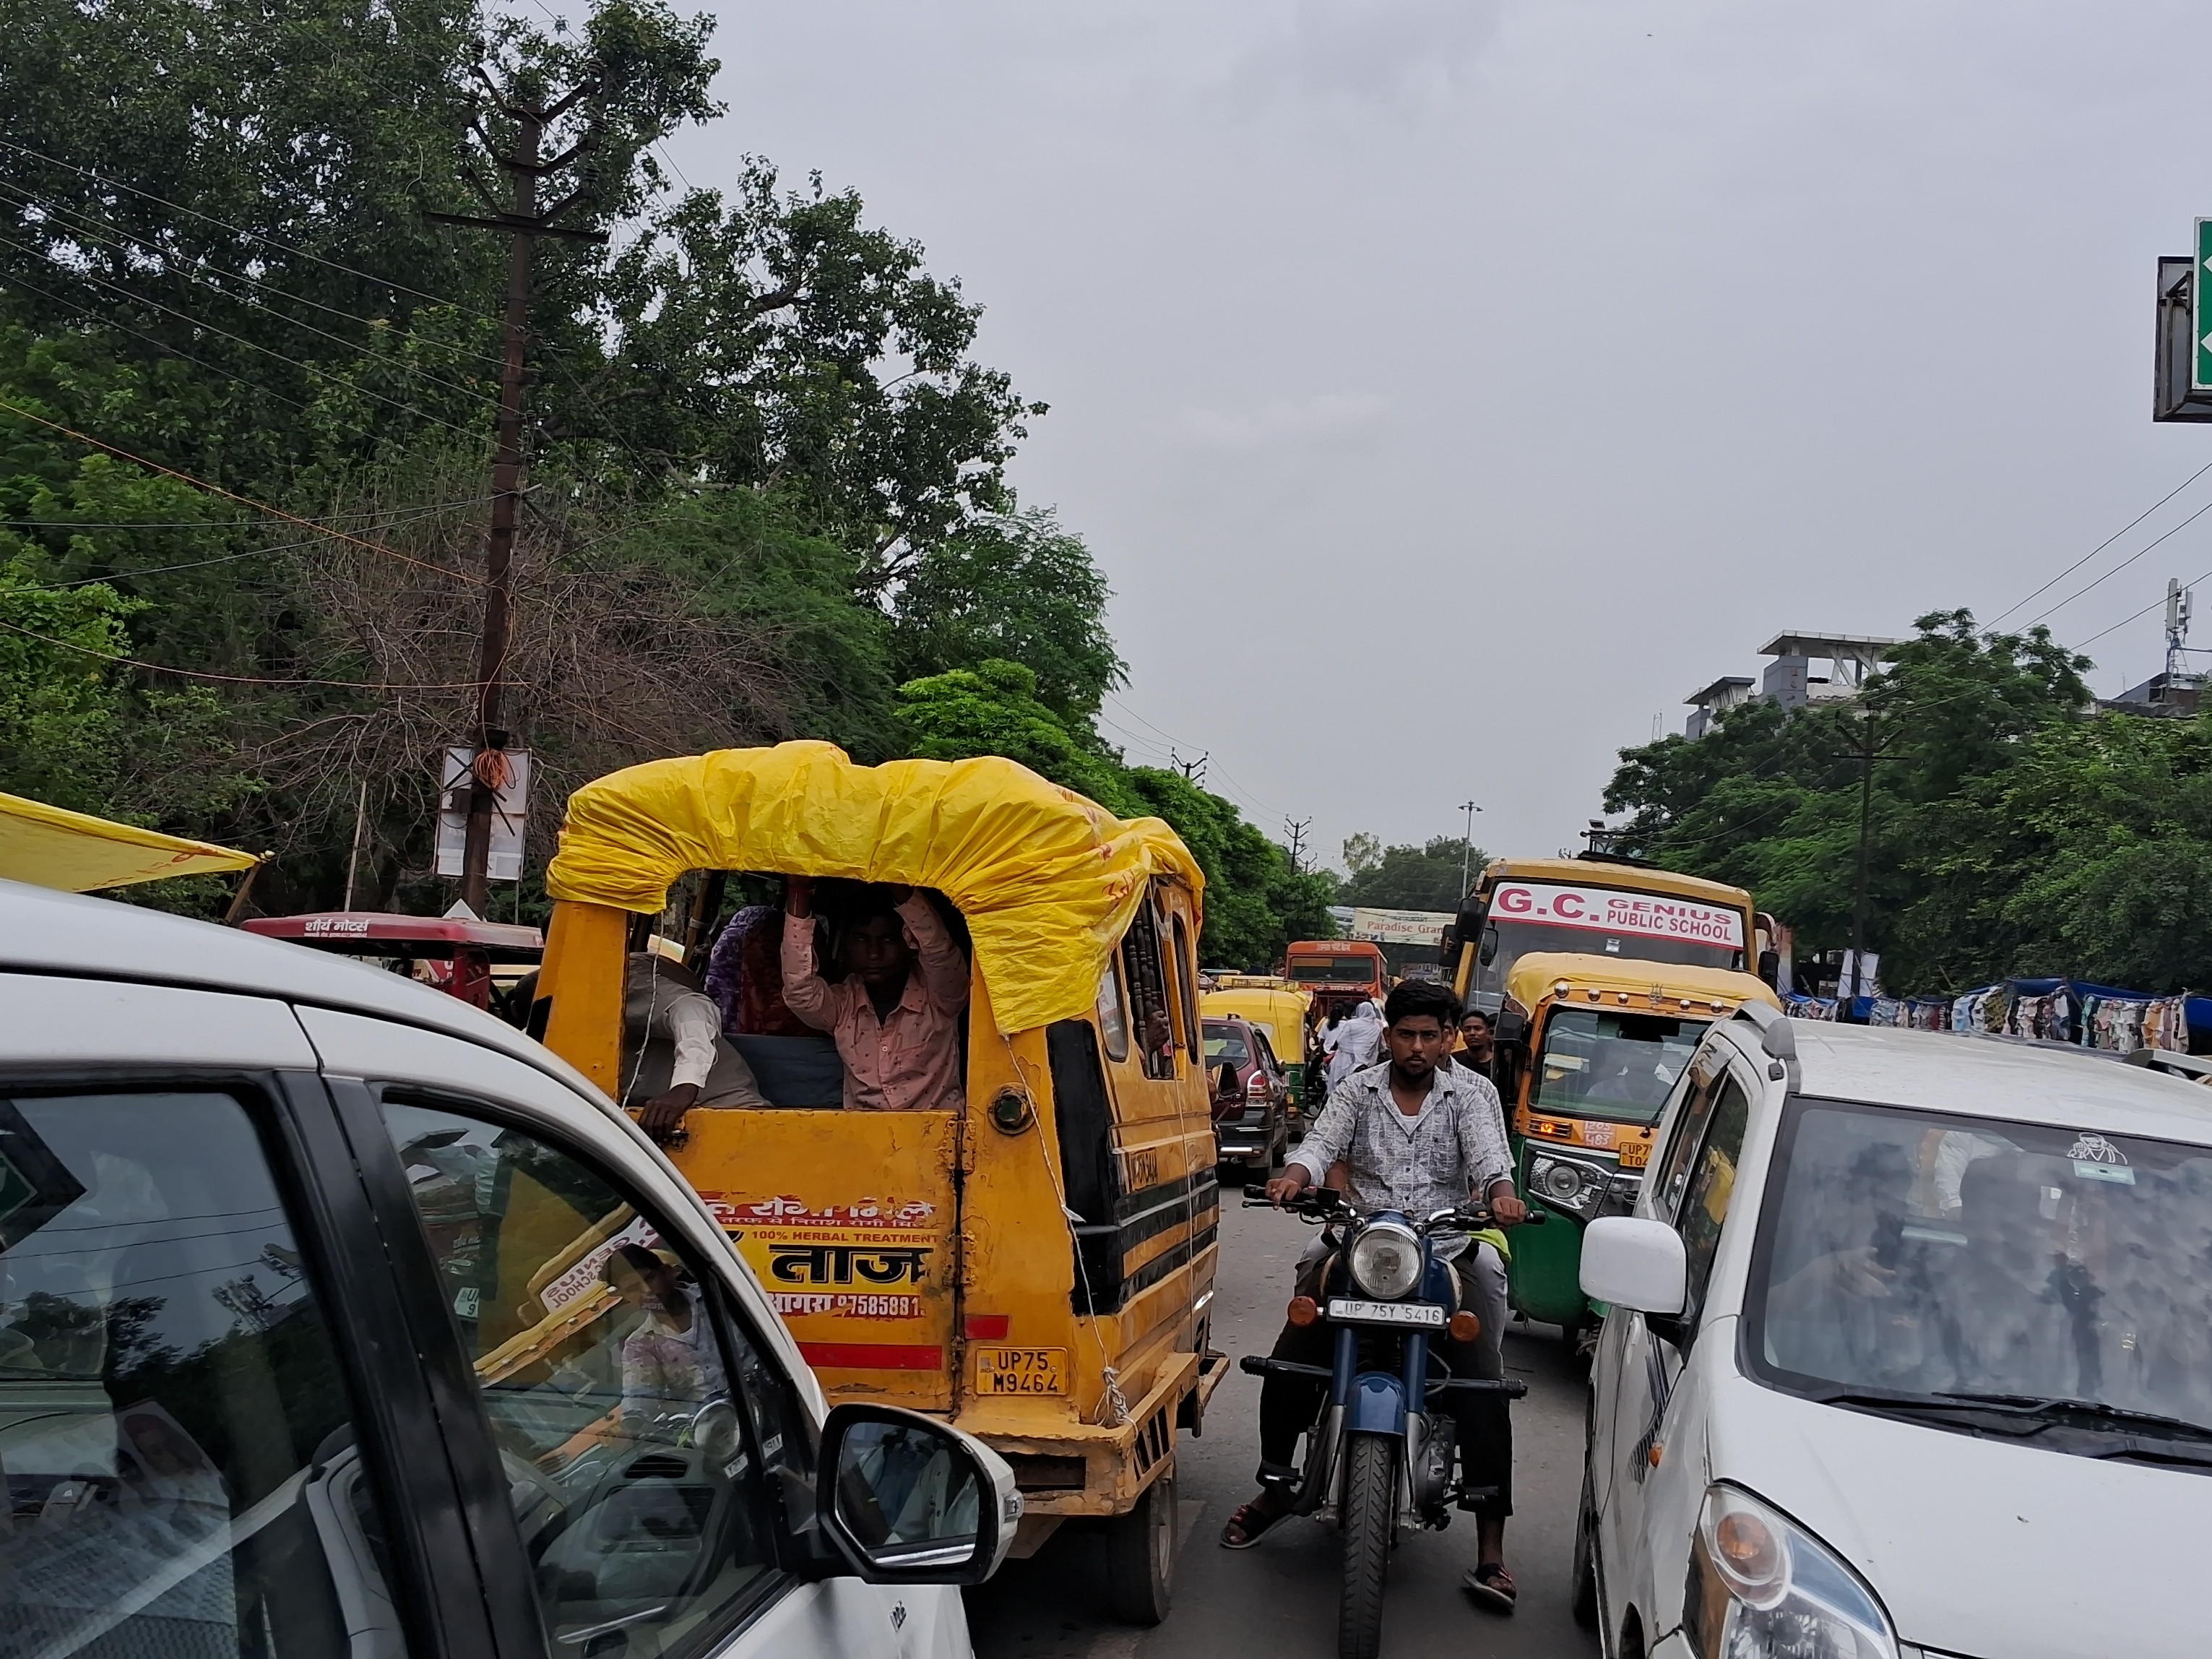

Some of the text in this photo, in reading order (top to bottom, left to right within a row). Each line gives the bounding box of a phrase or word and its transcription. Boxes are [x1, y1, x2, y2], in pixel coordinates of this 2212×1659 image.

[1498, 888, 1600, 922] G.C.
[1607, 898, 1732, 925] GENIUS
[1367, 921, 1413, 933] Paradise
[1607, 909, 1732, 941] PUBLIC SCHOOL
[1628, 1144, 1652, 1155] UP7
[751, 1231, 940, 1243] 100% HERBAL TREATMENT
[1345, 1302, 1440, 1322] UP 75Y 5416
[998, 1350, 1049, 1371] UP75
[993, 1372, 1058, 1393] M9464
